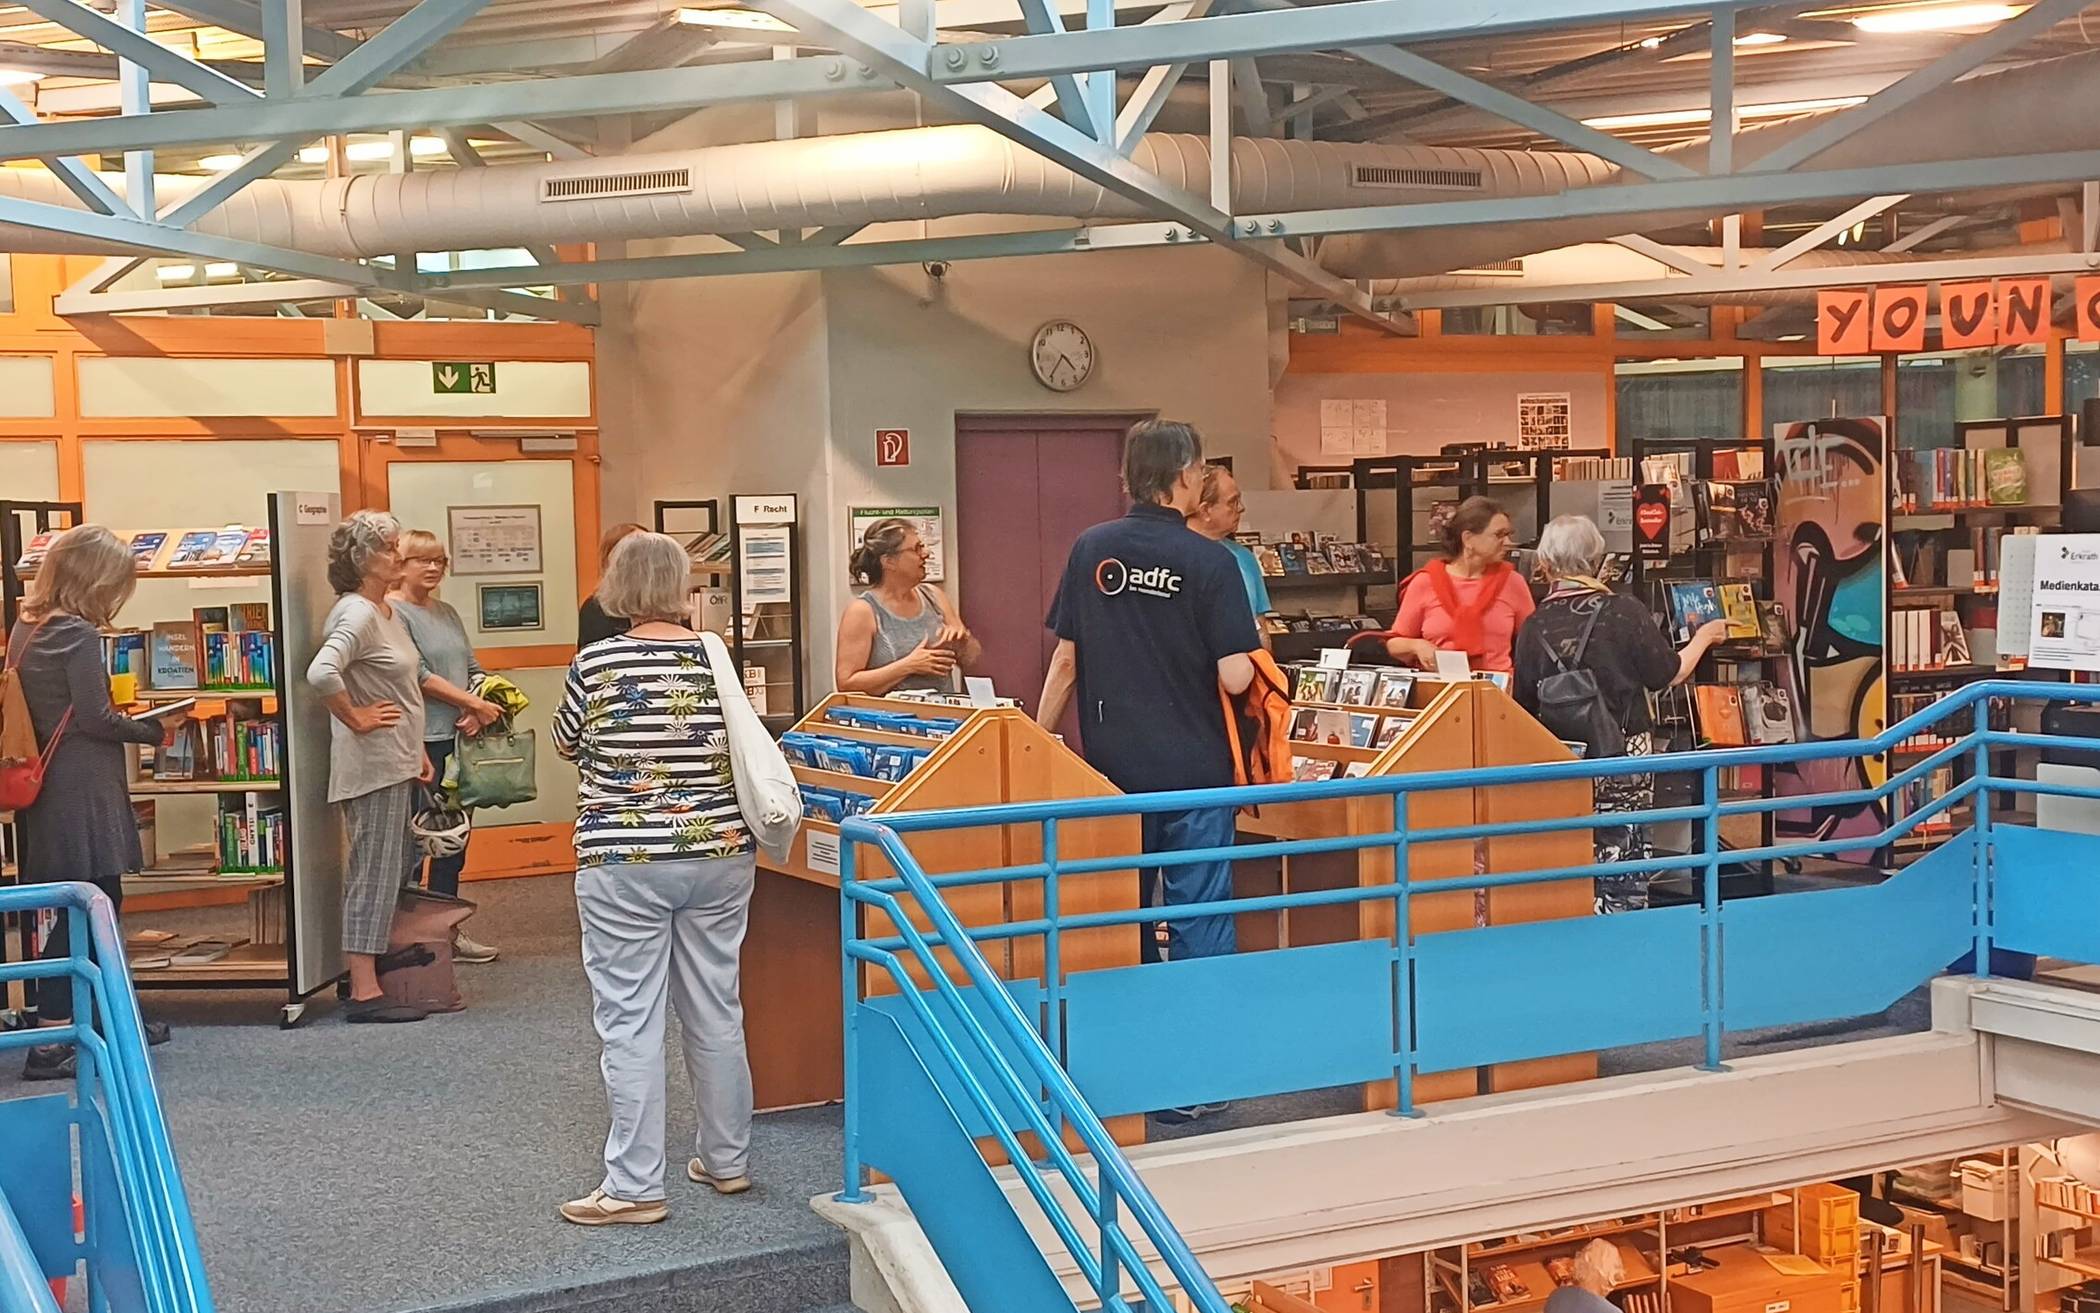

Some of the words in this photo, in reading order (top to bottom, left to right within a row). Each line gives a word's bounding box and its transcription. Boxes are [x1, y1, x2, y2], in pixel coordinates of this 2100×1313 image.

[763, 505, 787, 513] Recht
[1129, 566, 1183, 592] adfc
[2040, 580, 2100, 591] Medienkata
